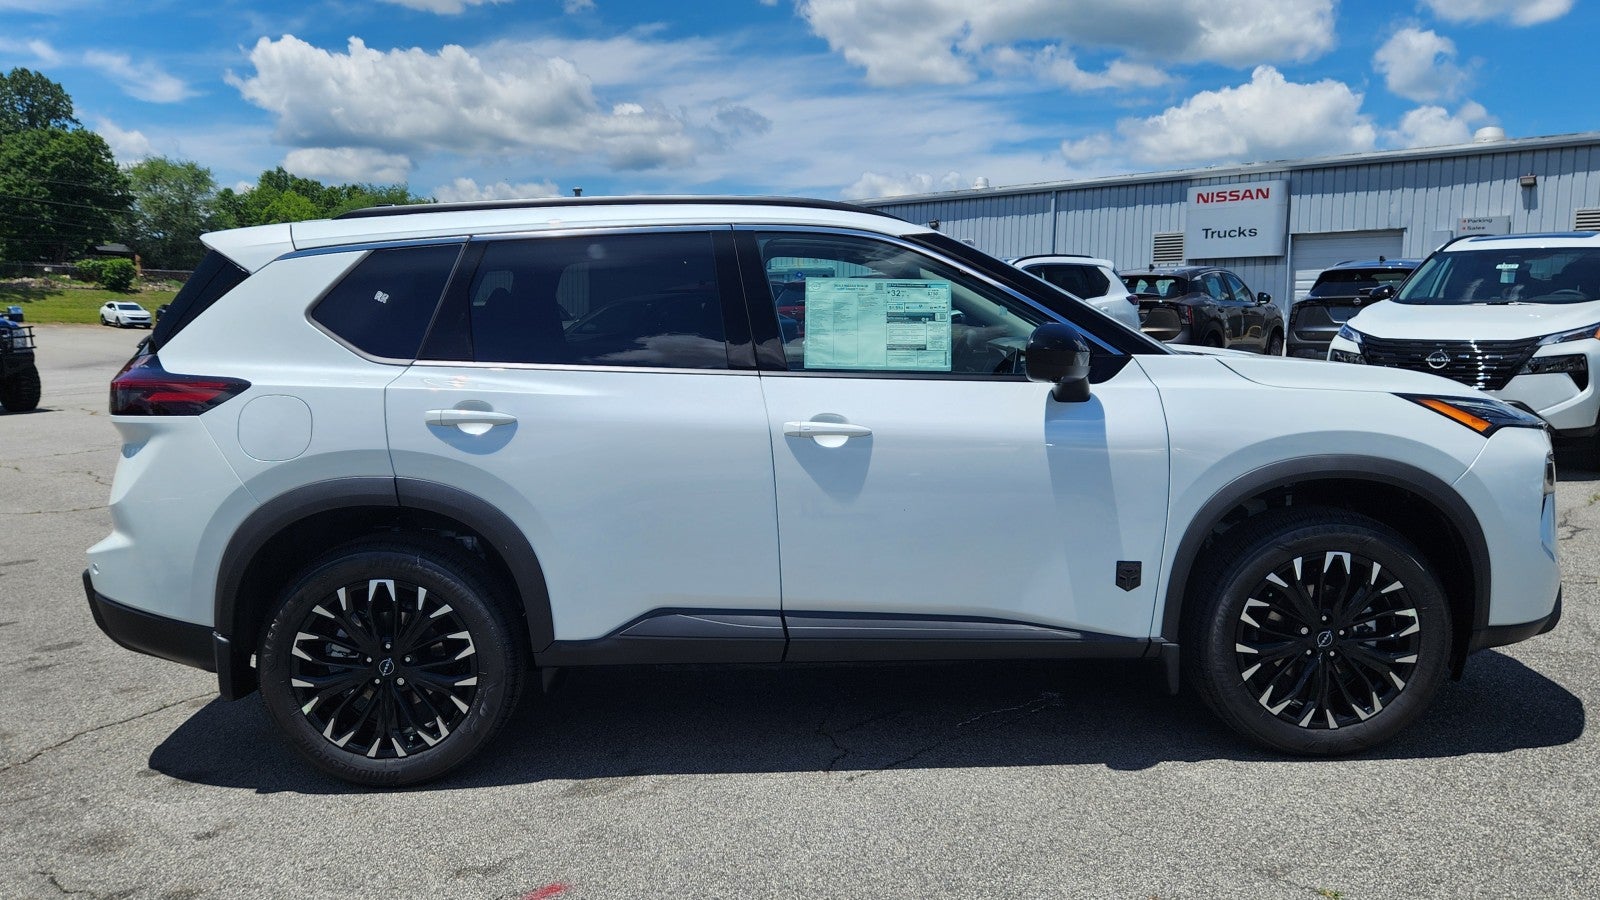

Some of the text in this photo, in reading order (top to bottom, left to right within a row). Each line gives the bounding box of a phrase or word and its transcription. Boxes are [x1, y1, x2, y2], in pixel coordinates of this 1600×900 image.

[1197, 188, 1269, 204] NISSAN
[1202, 227, 1258, 239] Trucks
[891, 289, 901, 297] 32
